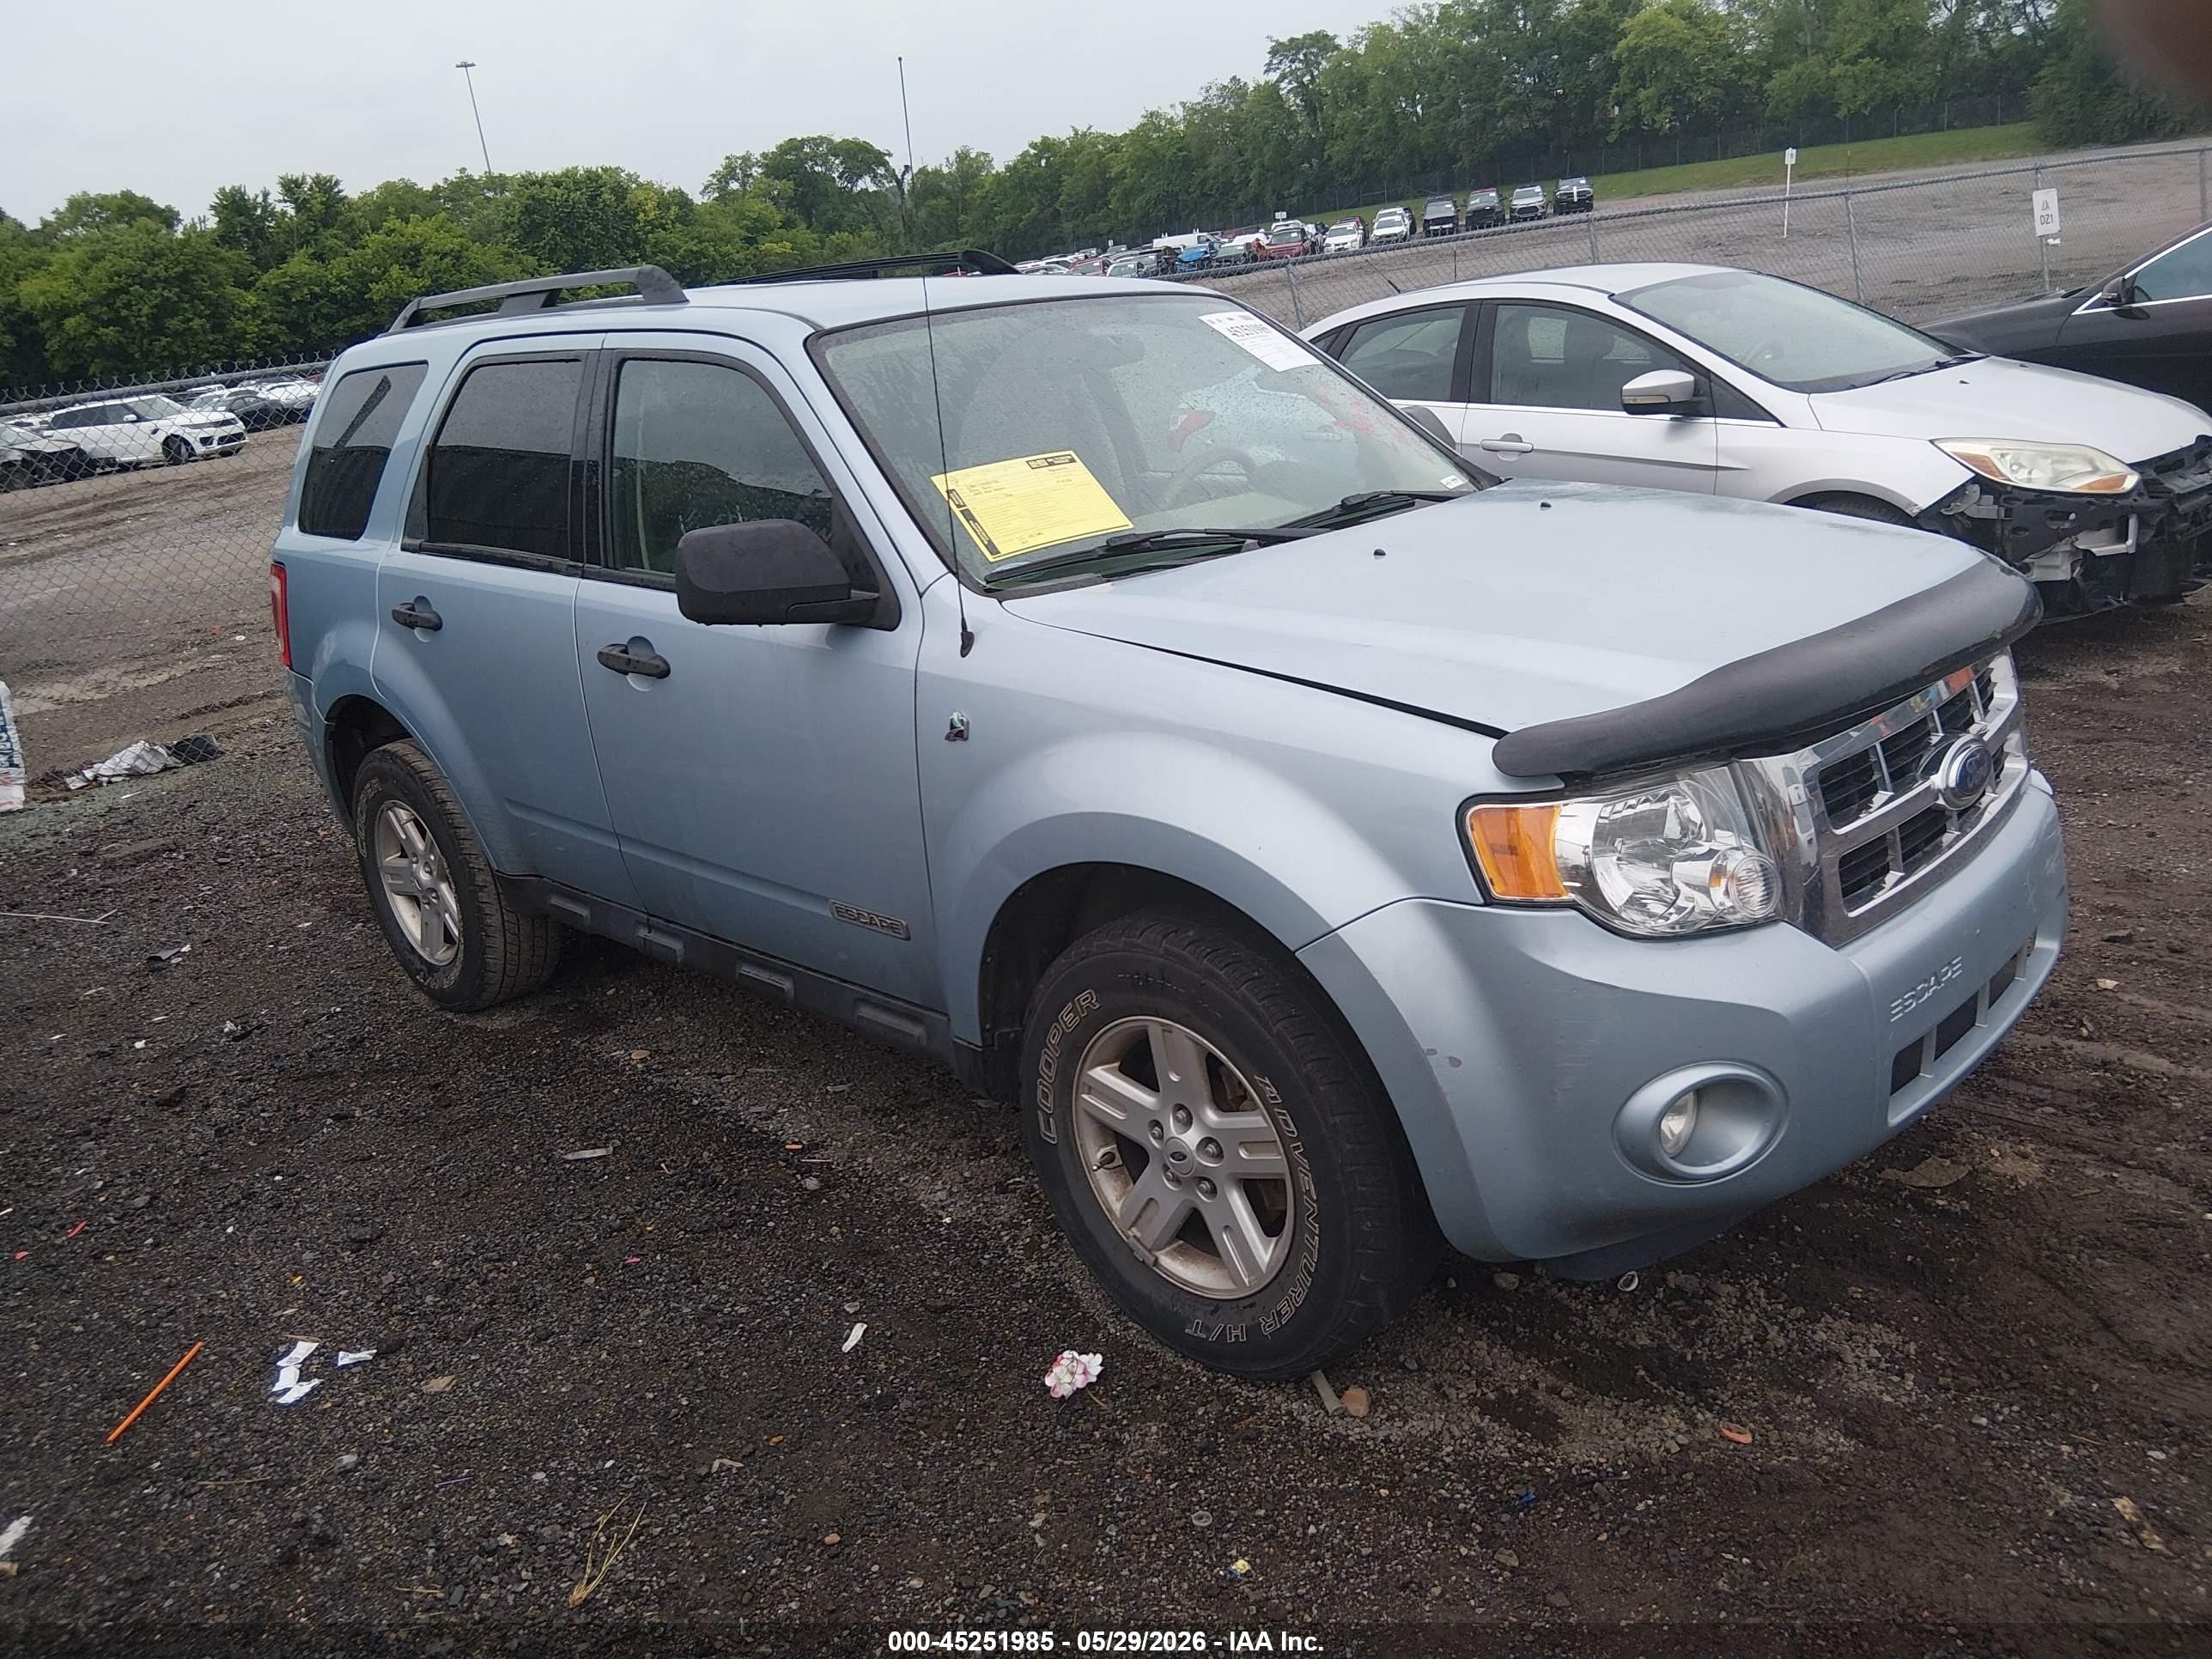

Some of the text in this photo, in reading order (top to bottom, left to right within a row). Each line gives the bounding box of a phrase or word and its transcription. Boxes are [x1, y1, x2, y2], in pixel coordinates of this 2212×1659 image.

[833, 903, 906, 937] ESCAPE
[1890, 955, 1963, 1023] ESCAPE
[1036, 988, 1101, 1145] COOPER
[1185, 1073, 1320, 1343] ADVENTURER H/T
